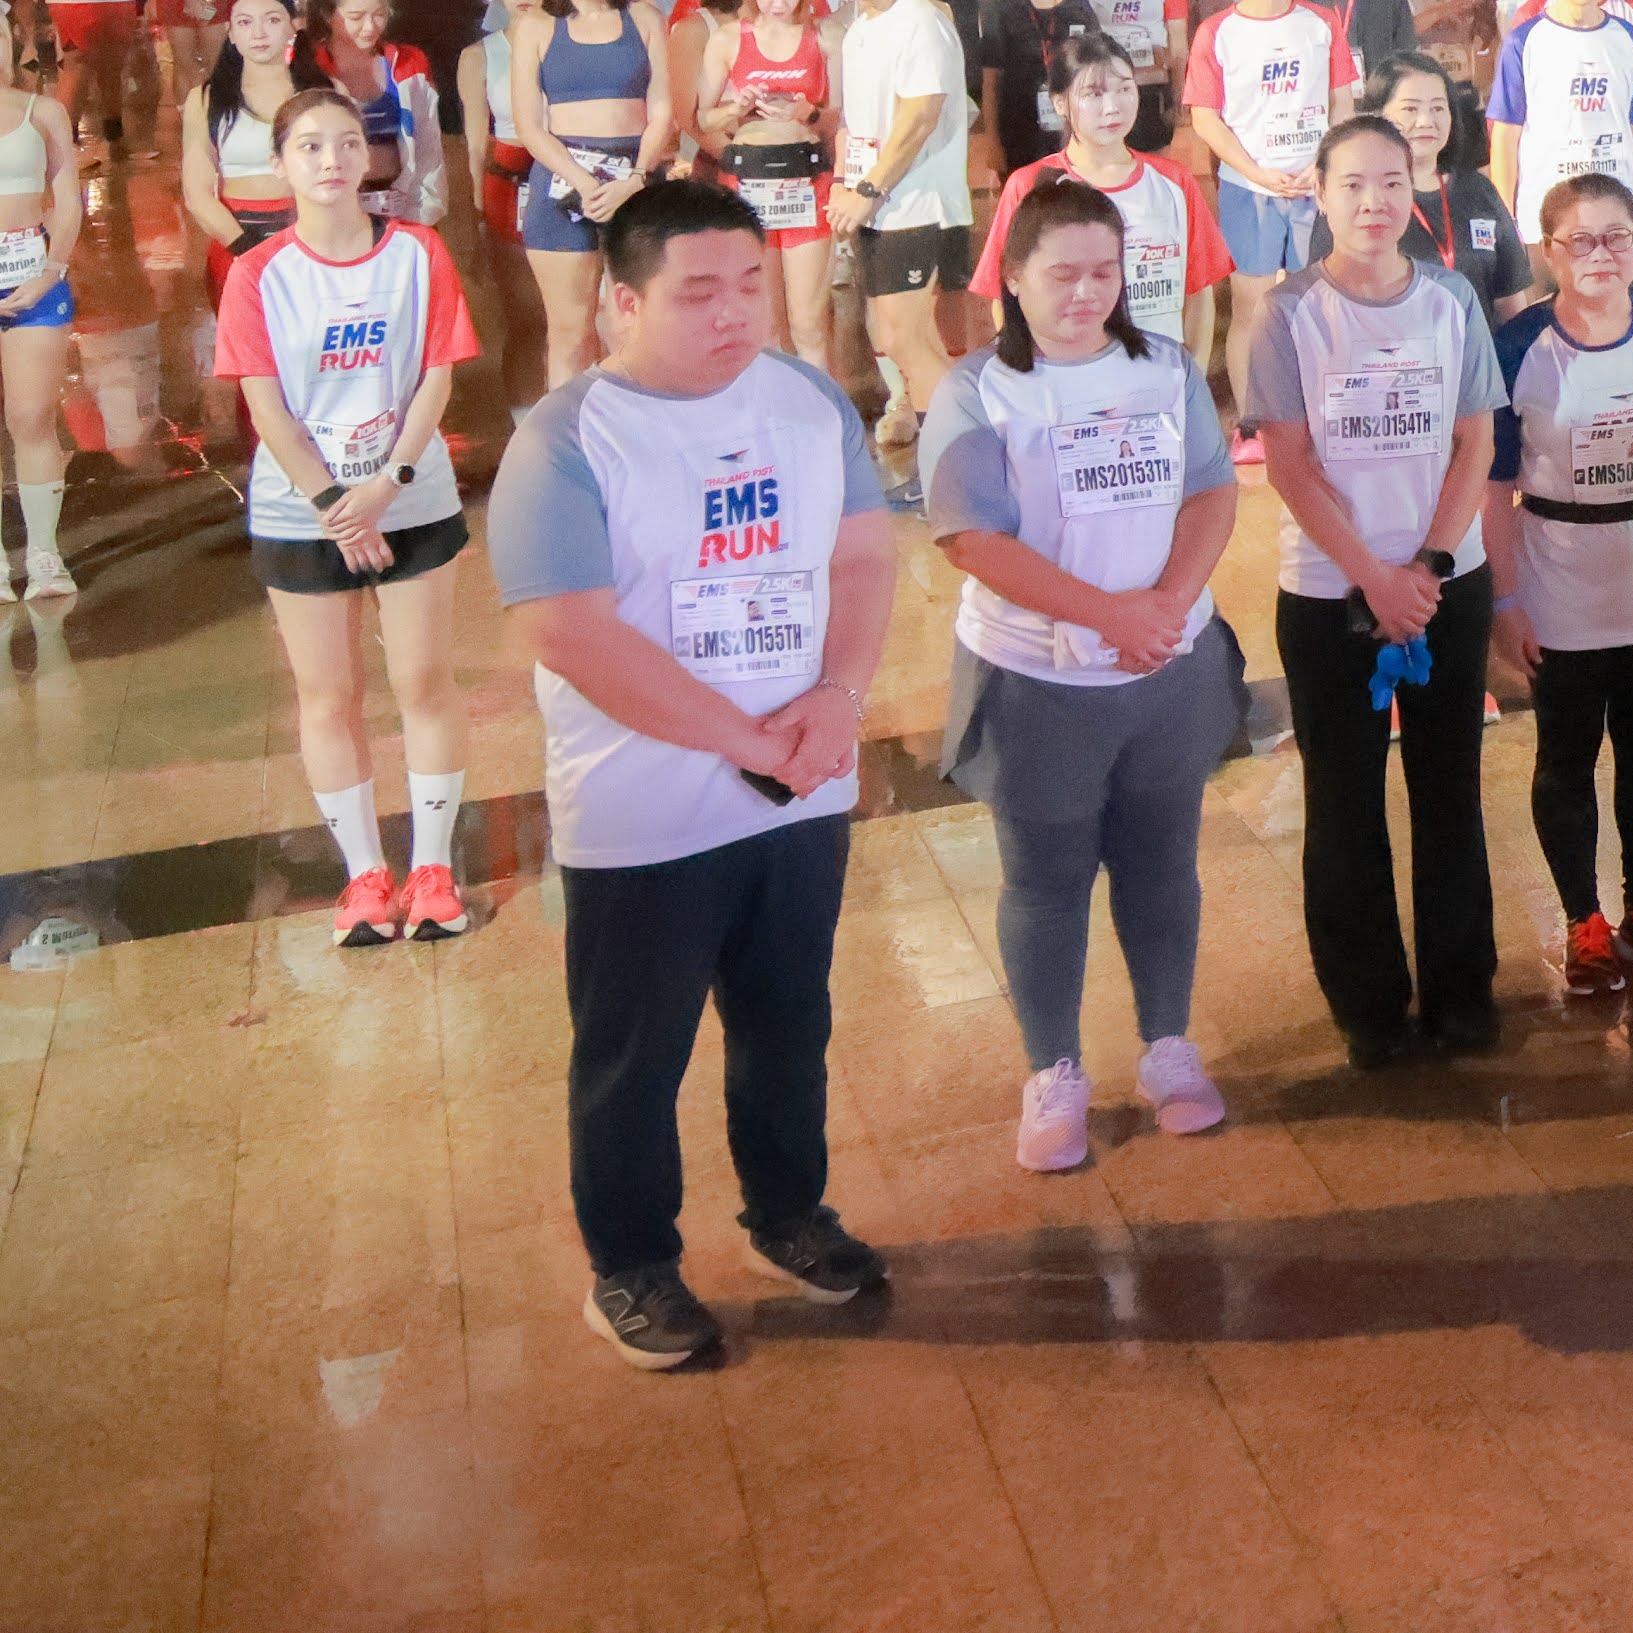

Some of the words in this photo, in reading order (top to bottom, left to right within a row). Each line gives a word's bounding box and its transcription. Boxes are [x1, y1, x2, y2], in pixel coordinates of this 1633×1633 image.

[1113, 0, 1141, 13] EMS
[1262, 60, 1300, 82] EMS
[1570, 77, 1608, 96] EMS
[1475, 229, 1492, 239] EMS
[322, 320, 388, 352] EMS
[319, 347, 383, 373] RUN
[1344, 377, 1370, 389] EMS
[316, 426, 333, 436] EMS
[355, 421, 379, 439] 10K
[1074, 426, 1099, 439] EMS
[1342, 411, 1431, 439] EMS20154TH
[1590, 429, 1614, 440] EMS
[704, 471, 750, 486] THAILAND
[752, 465, 774, 478] POST
[1075, 458, 1171, 492] EMS20153TH
[704, 478, 779, 531] EMS
[698, 520, 780, 568] RUN
[697, 583, 730, 598] EMS
[693, 624, 802, 660] EMS20155TH
